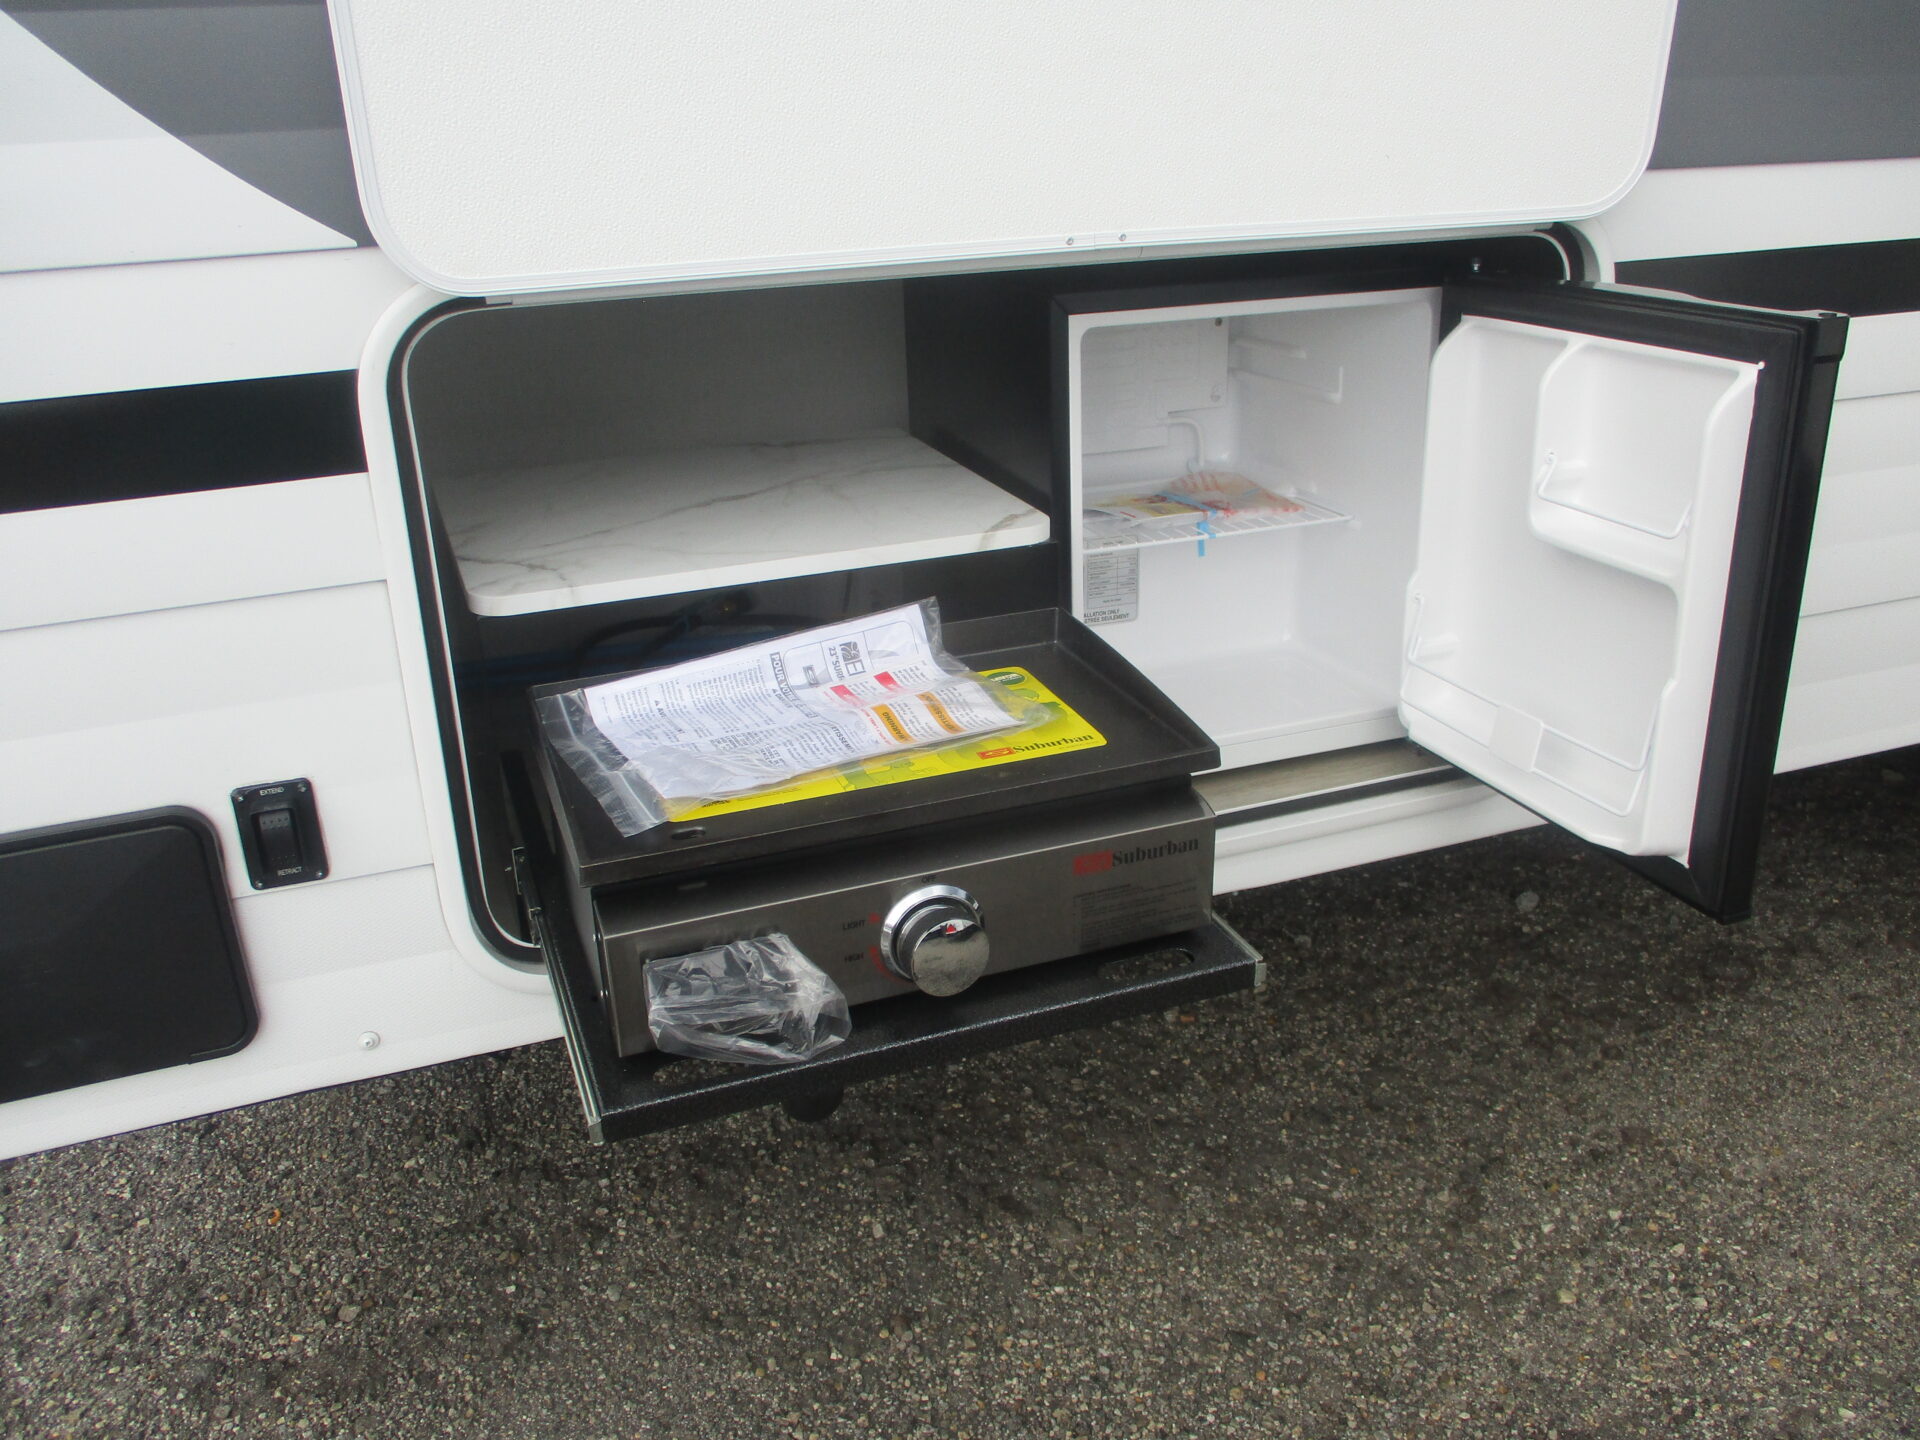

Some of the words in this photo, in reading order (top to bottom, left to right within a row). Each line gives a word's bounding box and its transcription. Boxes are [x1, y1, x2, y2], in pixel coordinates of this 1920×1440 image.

[771, 654, 786, 682] POUR
[1013, 734, 1095, 753] Suburban
[260, 786, 284, 796] EXTEND
[1111, 839, 1199, 867] Suburban
[277, 866, 302, 877] RETRACT
[842, 919, 866, 932] LIGHT
